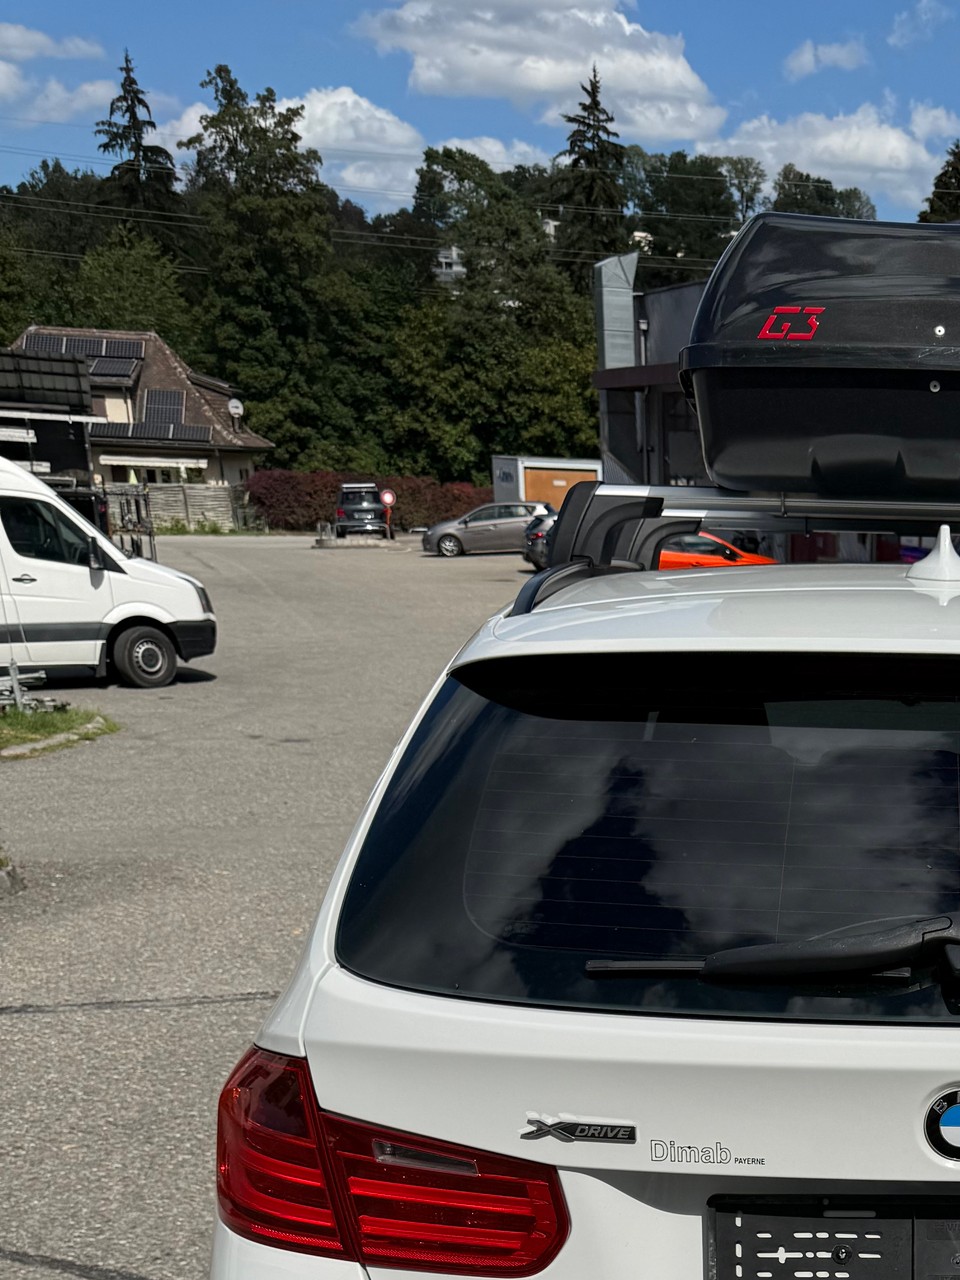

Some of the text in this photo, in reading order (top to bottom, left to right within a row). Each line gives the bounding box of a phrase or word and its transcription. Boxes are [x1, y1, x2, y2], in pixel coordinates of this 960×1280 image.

[757, 306, 826, 341] G3
[650, 1140, 766, 1166] Dimab PAYERNE
